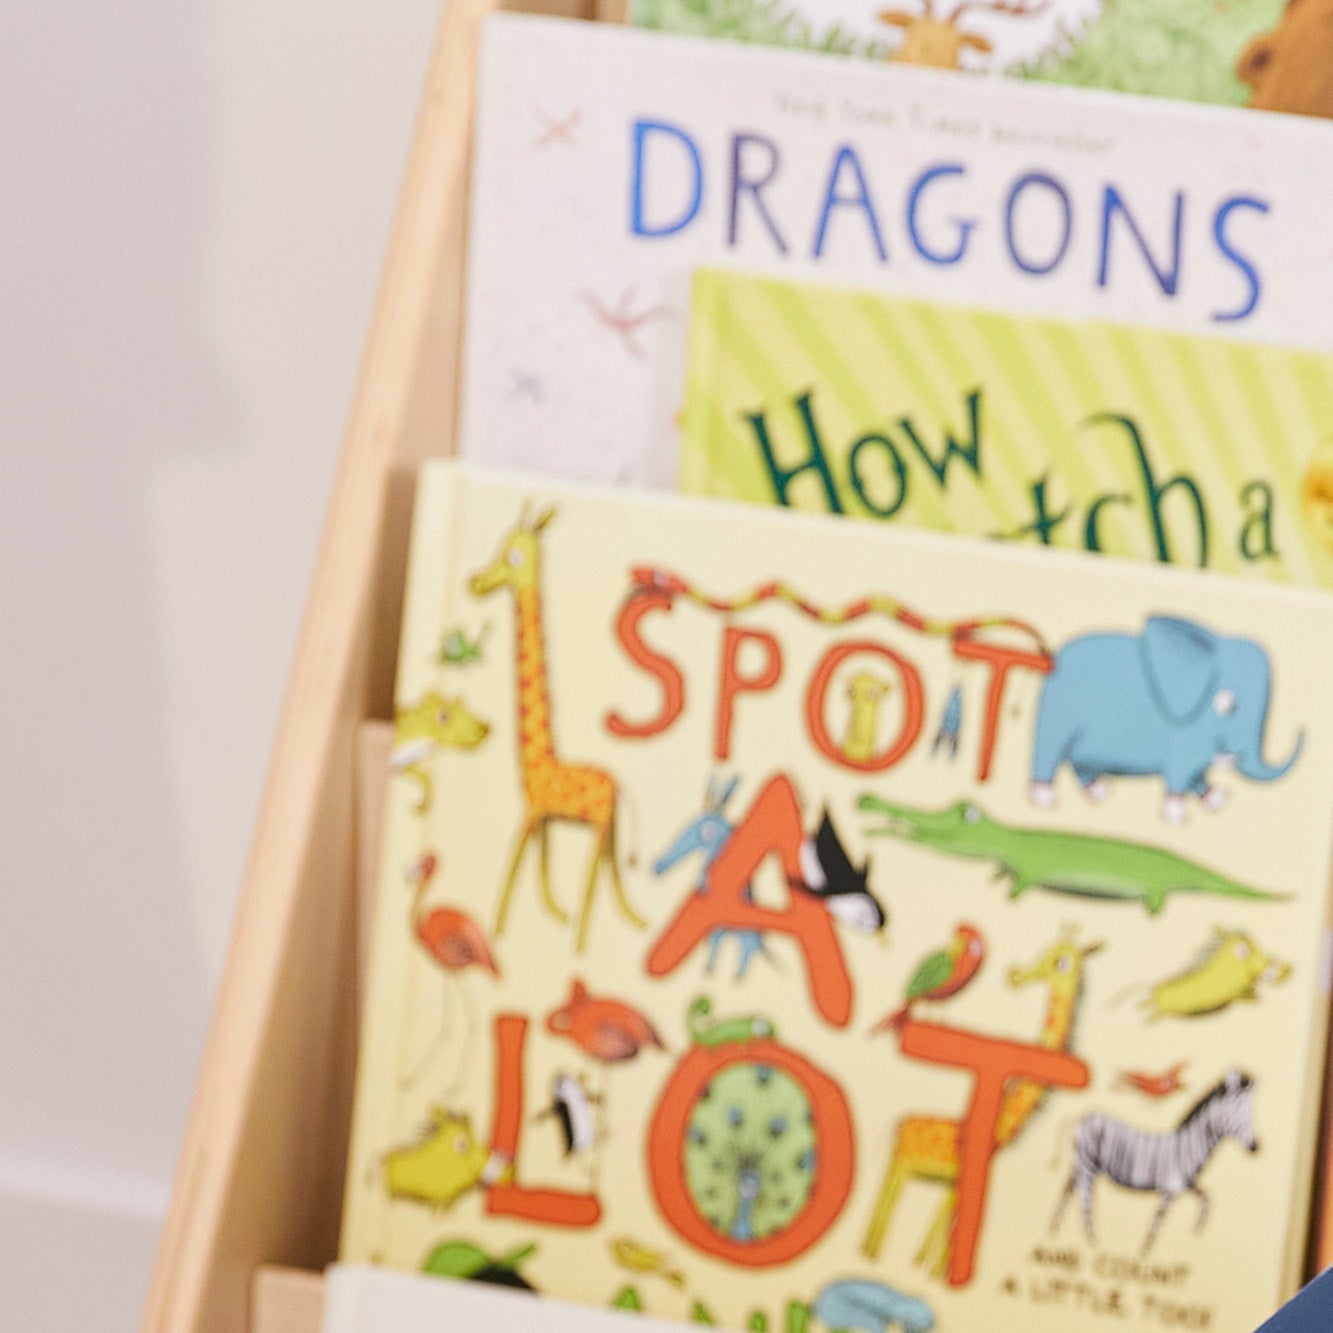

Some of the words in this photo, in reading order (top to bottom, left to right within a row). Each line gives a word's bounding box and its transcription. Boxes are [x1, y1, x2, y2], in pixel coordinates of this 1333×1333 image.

[631, 116, 1270, 322] DRAGONS
[740, 387, 982, 518] How
[1237, 478, 1279, 562] a
[604, 588, 1056, 783] SPOT
[644, 773, 854, 1028] A
[484, 1012, 1090, 1288] LOT
